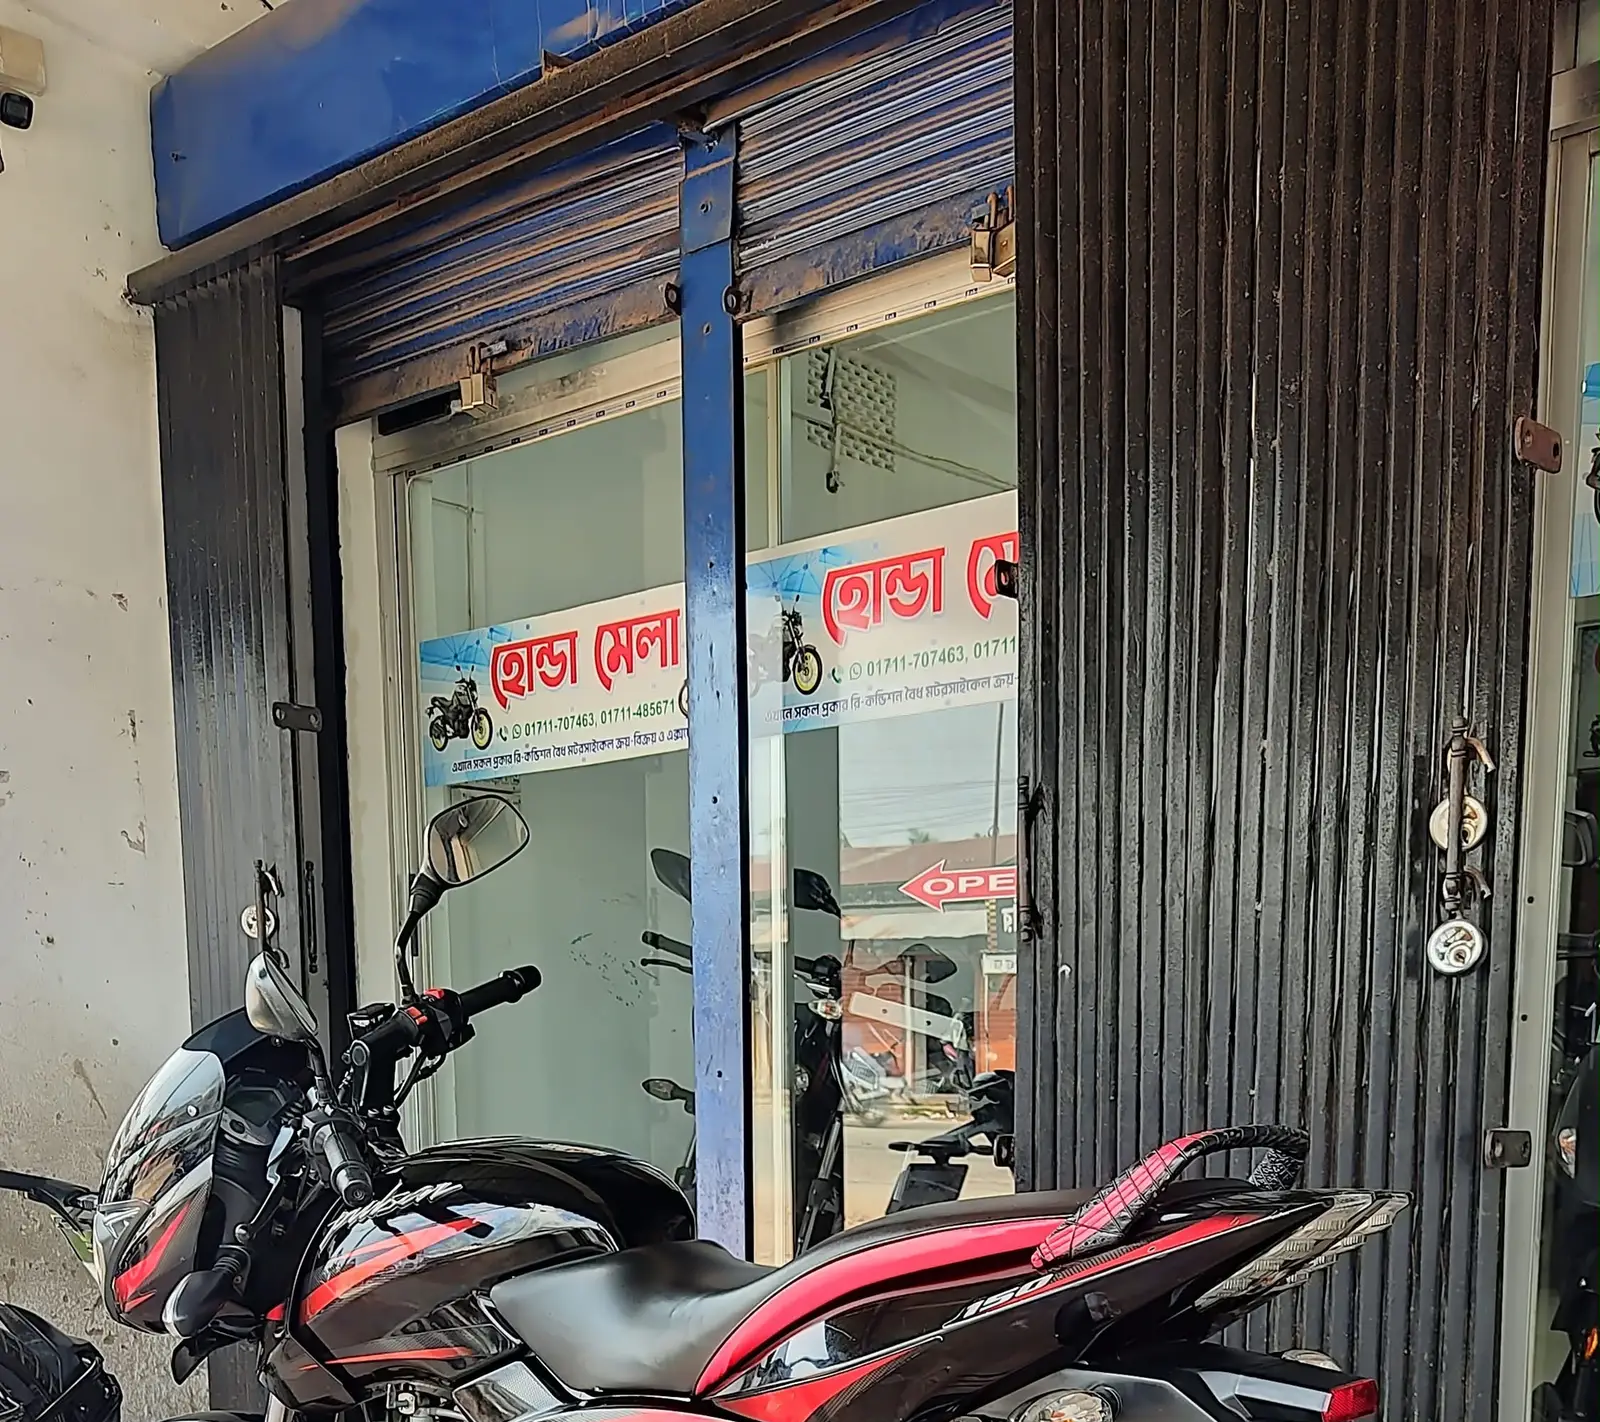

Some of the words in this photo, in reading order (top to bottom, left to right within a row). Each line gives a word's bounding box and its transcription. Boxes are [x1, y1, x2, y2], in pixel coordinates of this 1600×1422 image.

[821, 546, 946, 647] হোন্ডা
[490, 630, 579, 710] হোন্ডা
[594, 608, 681, 692] মেলা
[867, 646, 969, 677] 01711-707463,
[524, 711, 598, 737] 01711-707463,
[600, 700, 675, 724] 01711-485671
[794, 702, 819, 718] সকল
[821, 699, 849, 717] প্রকার
[452, 759, 473, 773] এখানে
[473, 757, 492, 770] সকল
[493, 754, 513, 769] প্রকার
[568, 739, 614, 756] মটরসাইকেল
[963, 1273, 1054, 1319] 150
